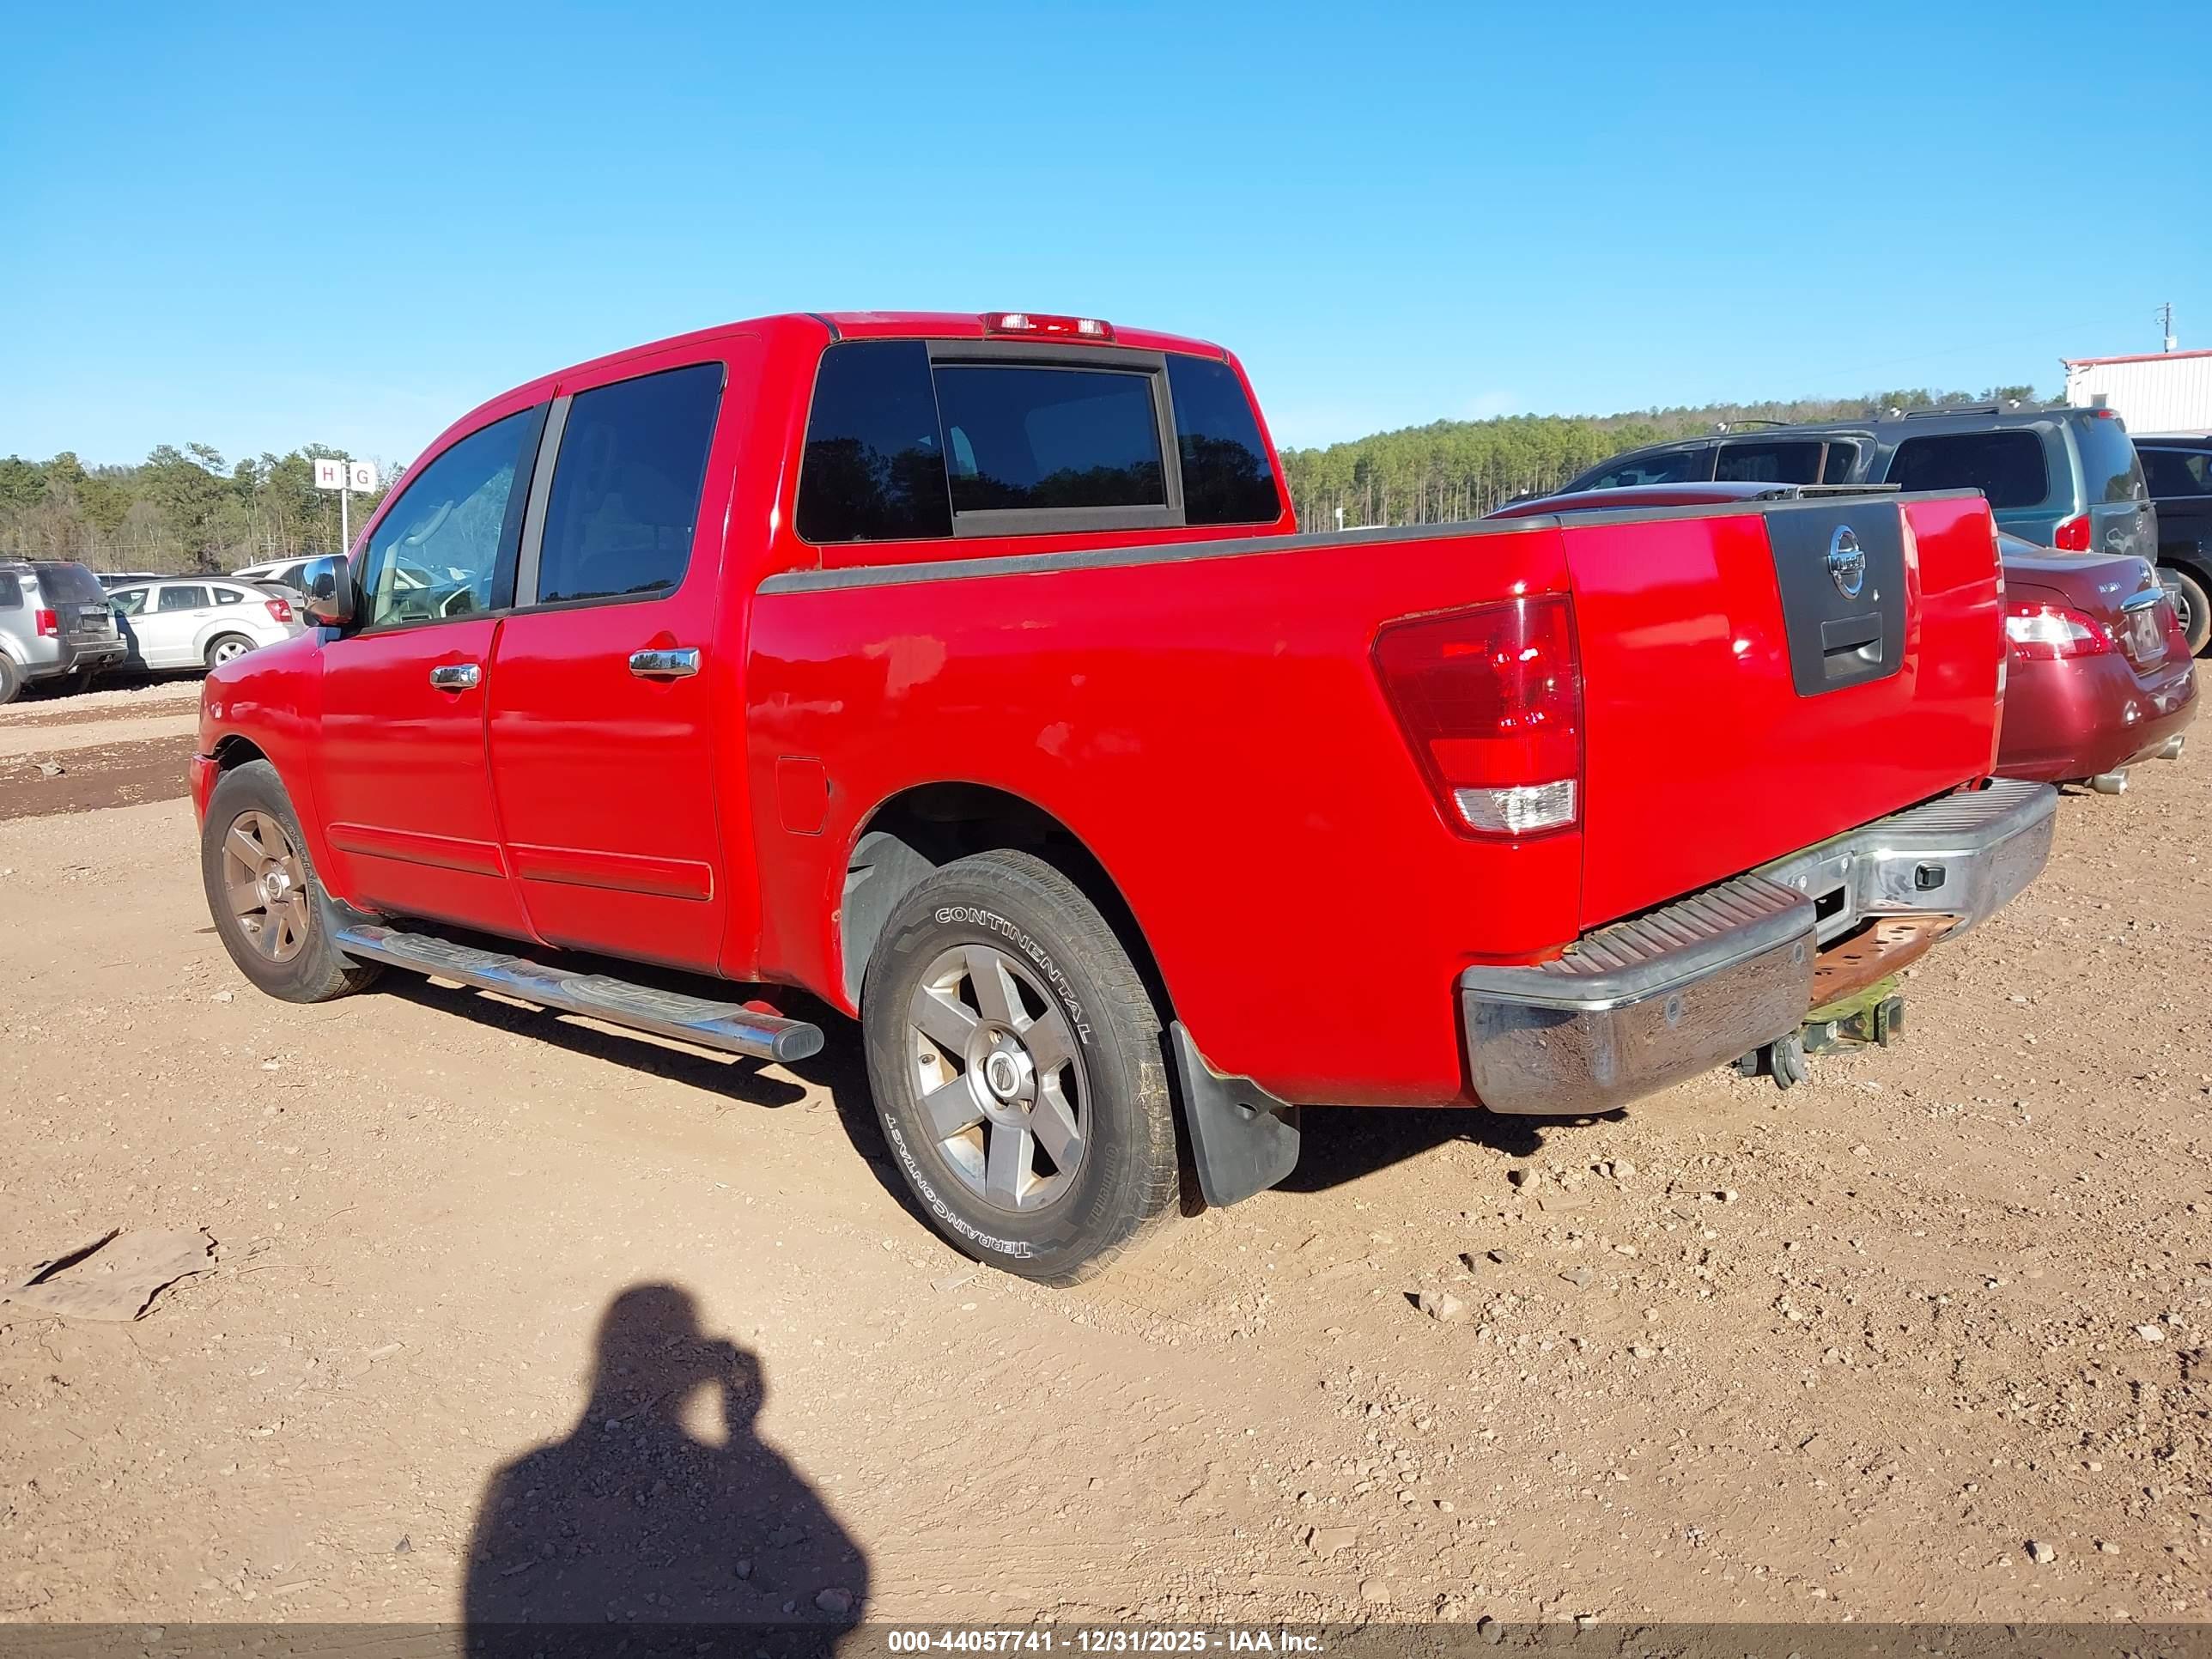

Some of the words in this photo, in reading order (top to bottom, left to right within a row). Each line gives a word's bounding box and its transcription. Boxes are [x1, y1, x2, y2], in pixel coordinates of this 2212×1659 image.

[322, 466, 334, 481] H
[356, 470, 368, 484] G
[935, 906, 1092, 1045] CONTINENTAL
